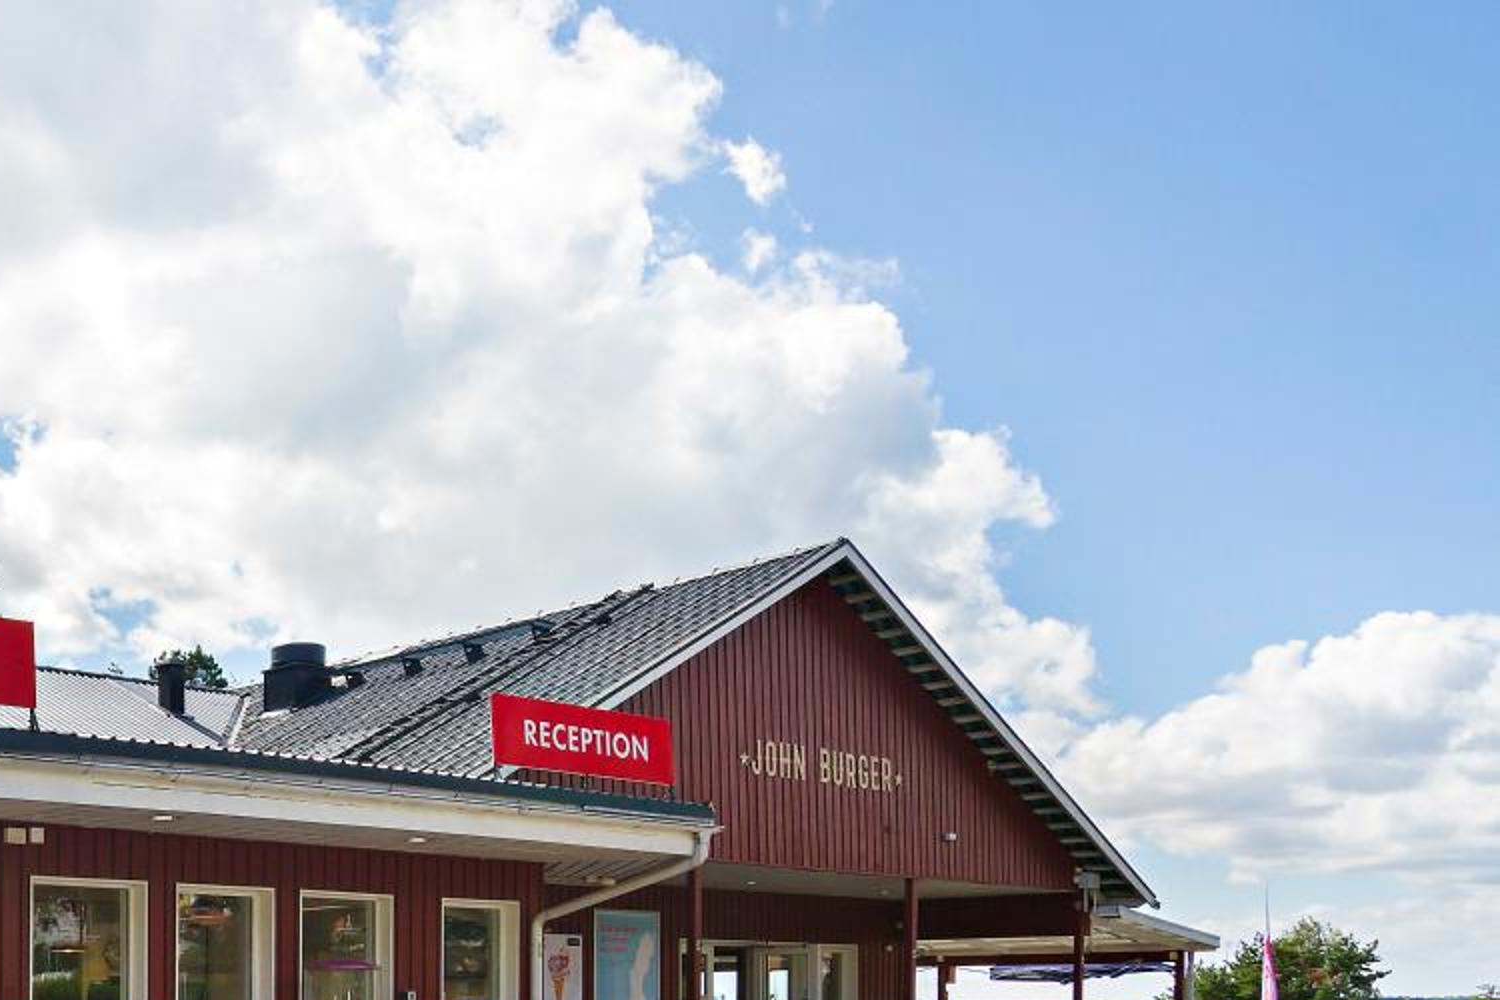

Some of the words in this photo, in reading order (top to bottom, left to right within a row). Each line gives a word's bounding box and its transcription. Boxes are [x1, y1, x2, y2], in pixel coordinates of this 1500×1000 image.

[523, 718, 650, 763] RECEPTION
[751, 739, 806, 781] JOHN
[819, 748, 893, 791] BURGER
